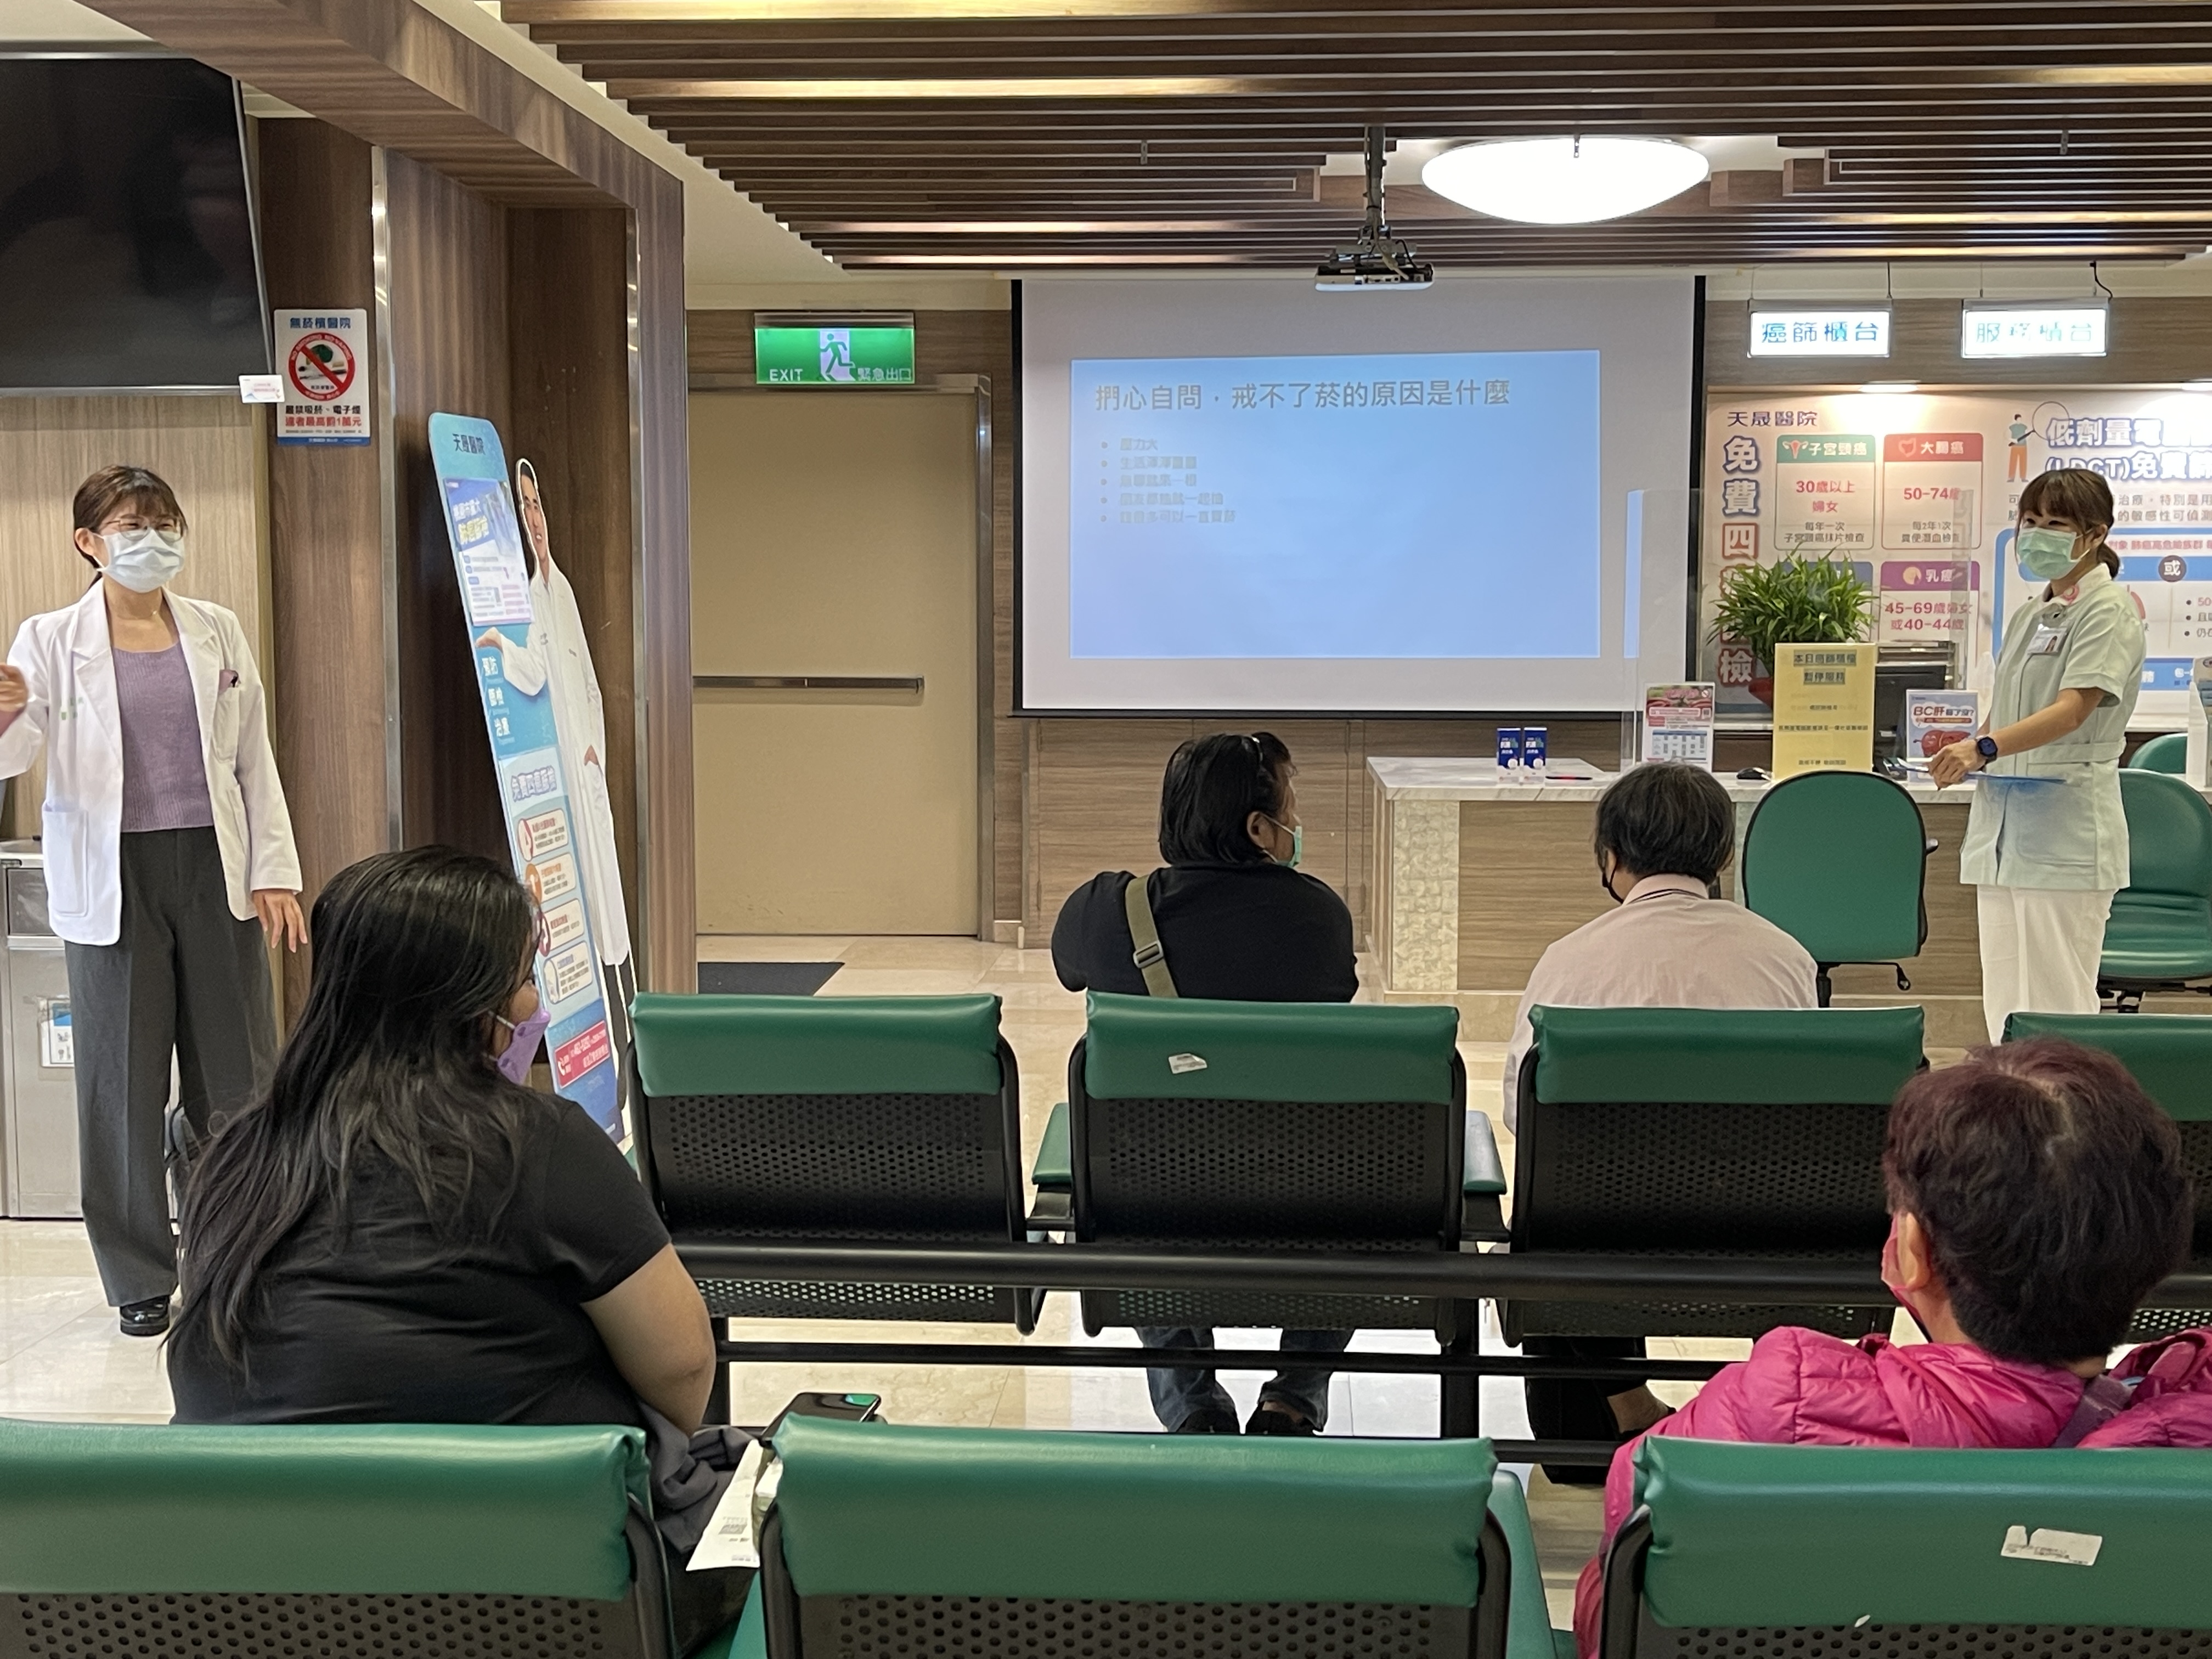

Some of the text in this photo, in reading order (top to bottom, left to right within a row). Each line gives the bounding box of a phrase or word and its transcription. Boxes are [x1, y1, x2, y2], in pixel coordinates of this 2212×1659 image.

[290, 317, 351, 329] 無菸檳醫院
[1761, 321, 1880, 344] 癌篩櫃台
[769, 369, 803, 382] EXIT
[857, 367, 912, 382] 緊急出口
[1727, 410, 1818, 427] 天晟醫院
[1920, 440, 1965, 455] 大腸癌
[1796, 479, 1856, 493] 30歲以上
[1903, 487, 1960, 501] 50-74歲
[1812, 500, 1839, 514] 婦女
[1804, 521, 1846, 532] 每年一次
[1912, 521, 1952, 532] 每2年1次
[2163, 560, 2181, 576] 或
